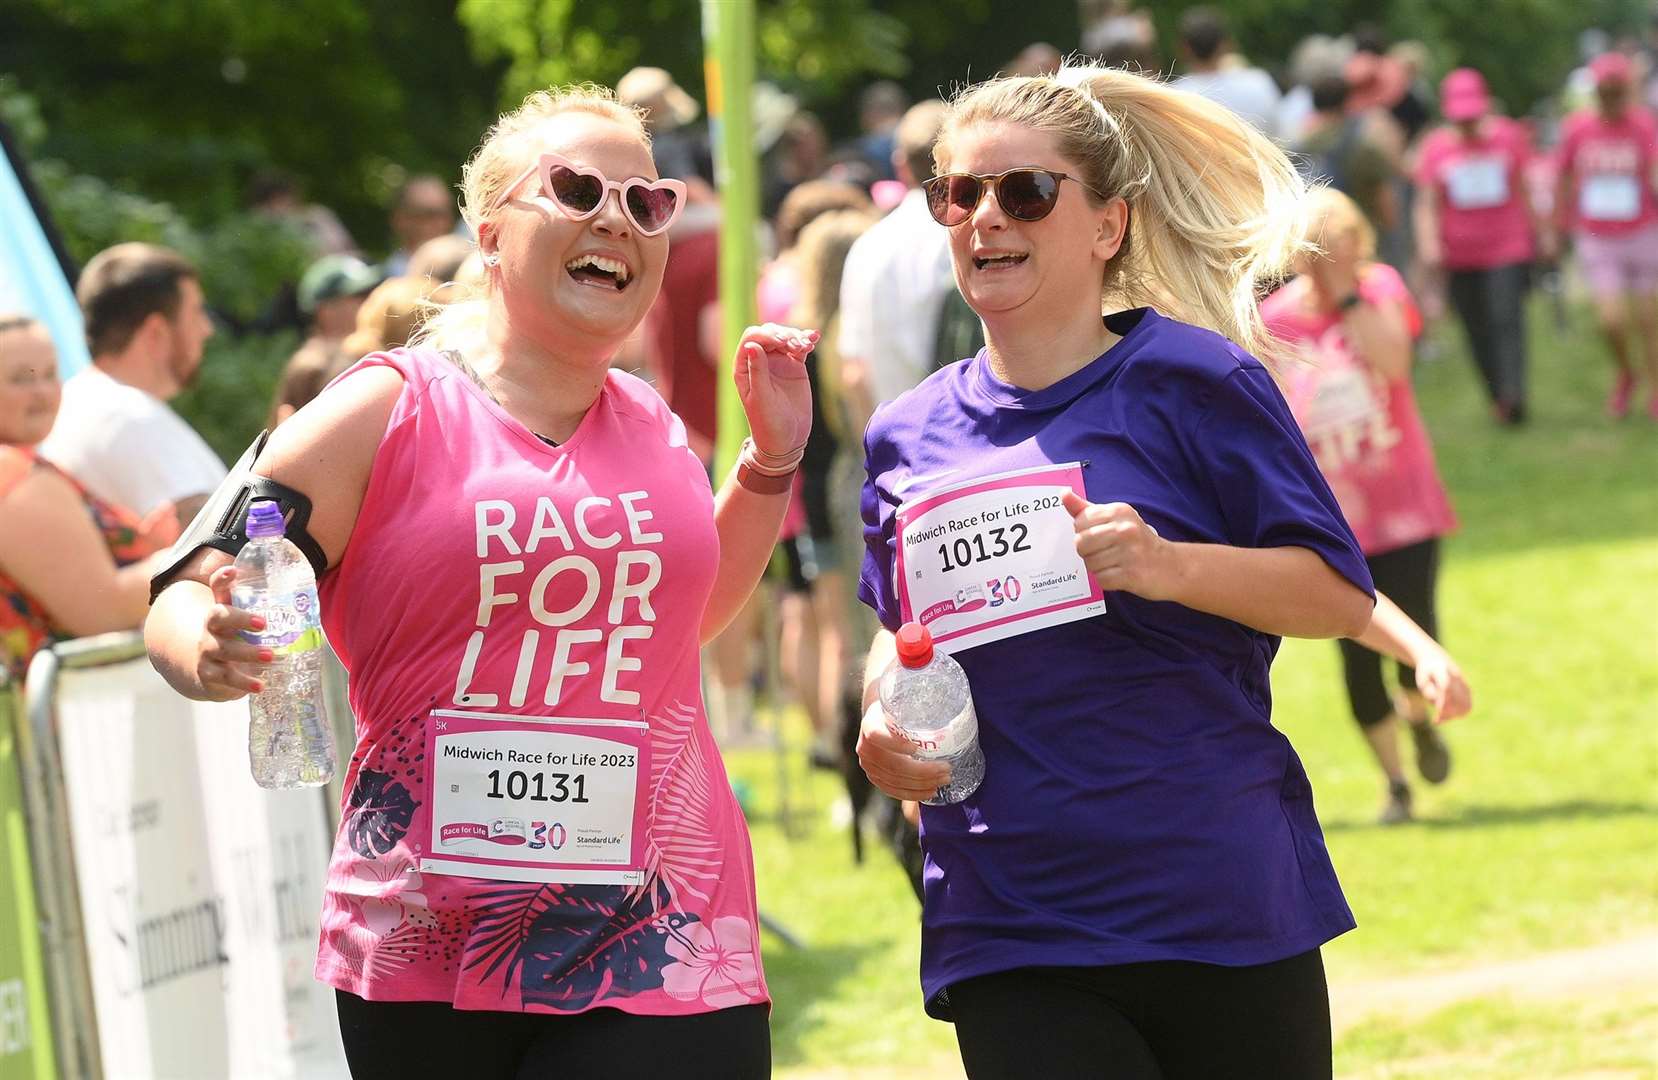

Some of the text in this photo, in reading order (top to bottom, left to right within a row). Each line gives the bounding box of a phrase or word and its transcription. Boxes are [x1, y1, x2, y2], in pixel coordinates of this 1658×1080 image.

[474, 490, 664, 558] RACE
[905, 495, 1063, 548] Midwich Race for Life 202
[938, 523, 1032, 573] 10132
[475, 550, 662, 627] FOR
[1031, 576, 1063, 590] Standard
[1063, 573, 1077, 582] Life
[942, 602, 953, 611] Life
[453, 625, 654, 707] LIFE
[435, 719, 448, 731] 5K
[443, 745, 635, 768] Midwich Race for Life 2023
[487, 769, 589, 804] 10131
[443, 826, 486, 836] Race for Life
[576, 836, 621, 845] Standard Life
